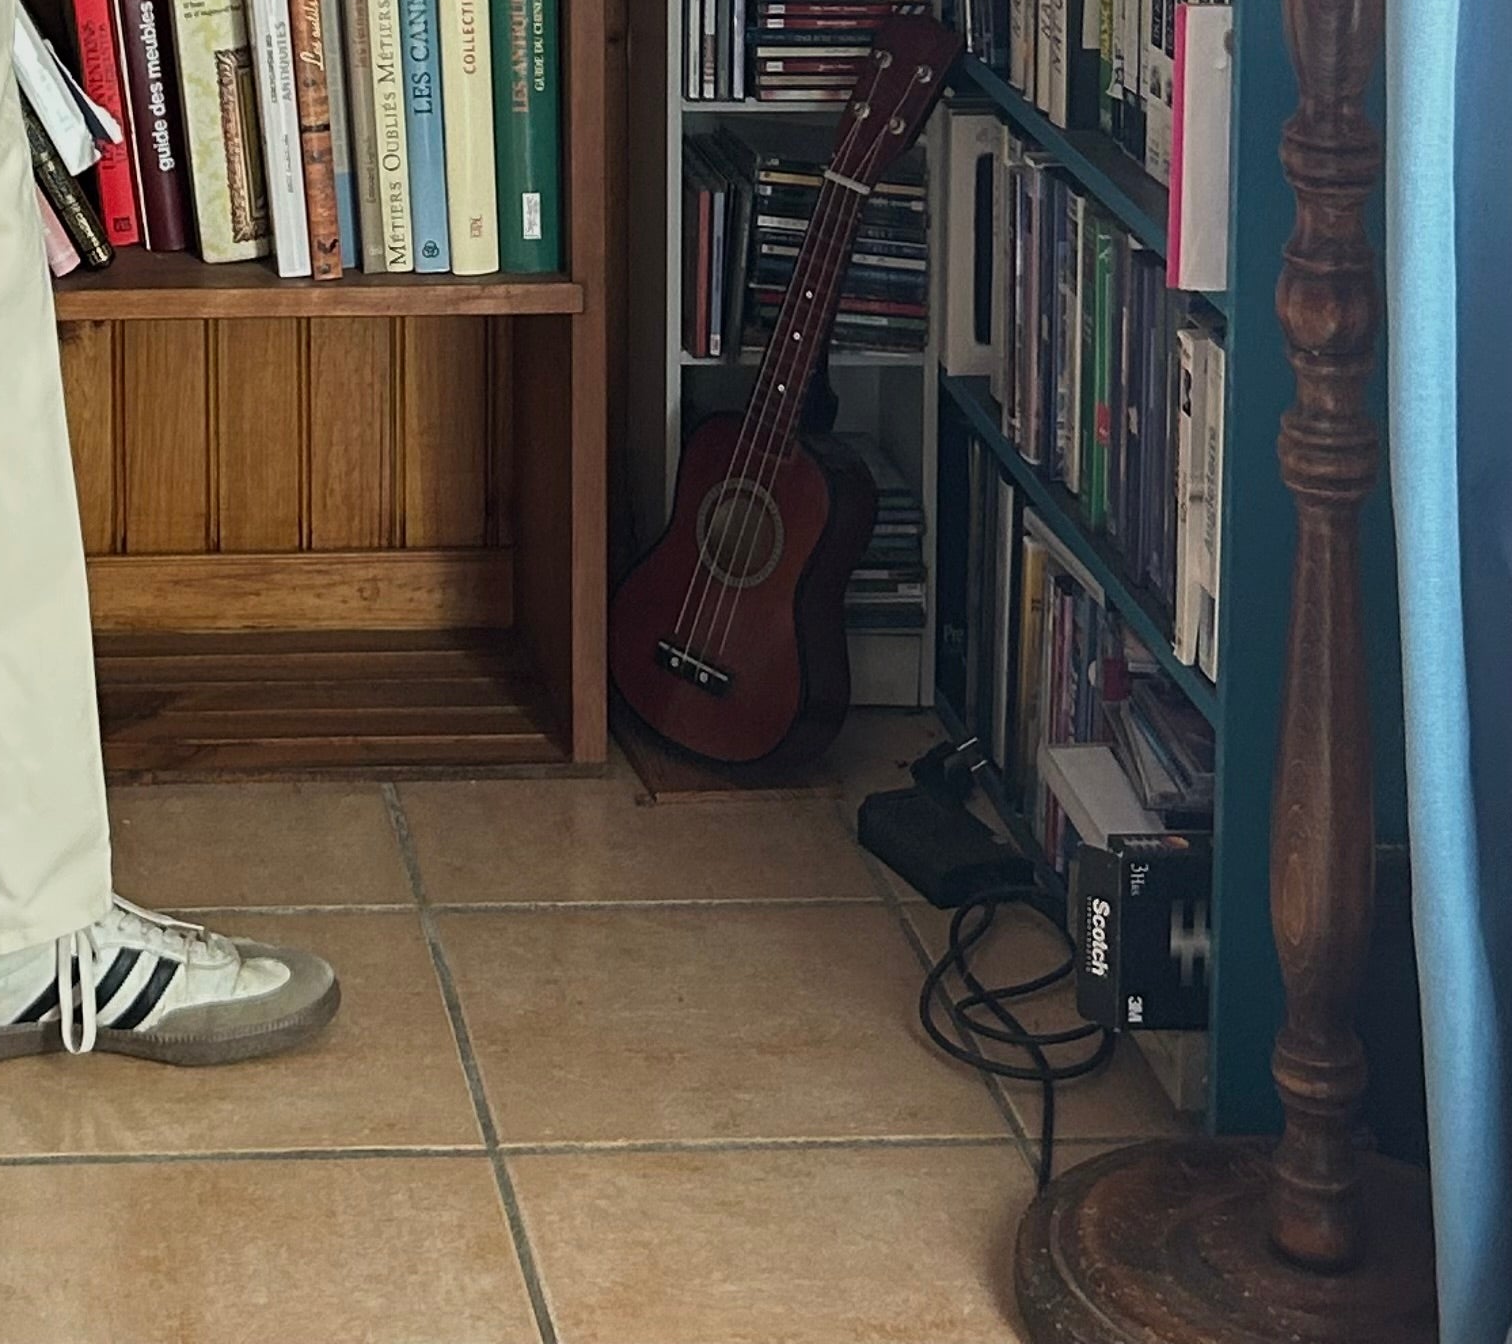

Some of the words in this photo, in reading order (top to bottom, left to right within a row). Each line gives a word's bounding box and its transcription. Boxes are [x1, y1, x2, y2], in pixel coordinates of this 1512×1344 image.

[139, 0, 163, 80] meubles
[378, 0, 396, 84] MÉTIERS
[533, 36, 545, 53] DU
[146, 80, 167, 117] des
[413, 69, 433, 116] LES
[533, 53, 546, 92] GUIDE
[149, 118, 176, 173] guide
[382, 92, 401, 171] OUBLIÉS
[388, 181, 406, 266] MÉTIERS
[1092, 898, 1111, 977] Scotch
[1127, 996, 1144, 1023] 3M
